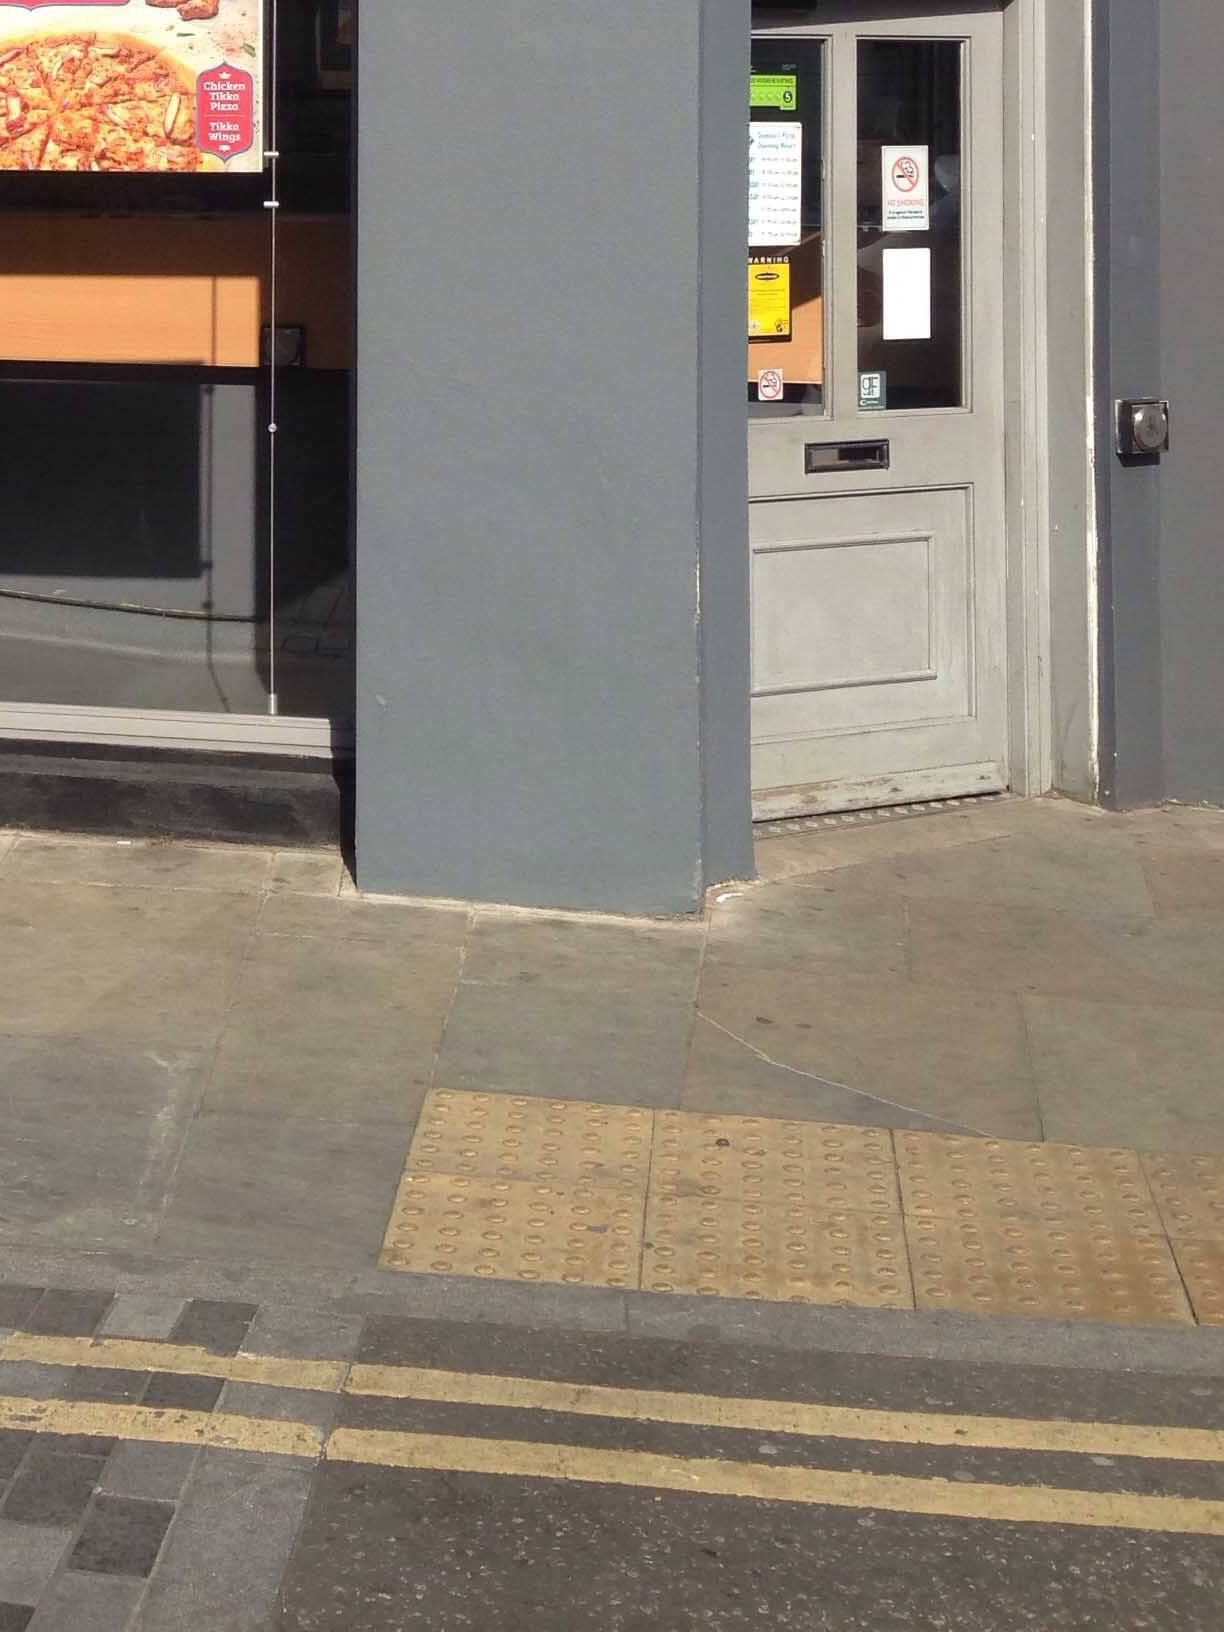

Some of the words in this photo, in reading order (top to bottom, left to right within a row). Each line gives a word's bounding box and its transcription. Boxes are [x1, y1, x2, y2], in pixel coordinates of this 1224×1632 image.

[203, 81, 246, 91] Chicken
[209, 91, 240, 101] Tikka
[210, 101, 239, 111] Pizza
[209, 121, 240, 131] Tikka
[208, 132, 241, 143] Wings
